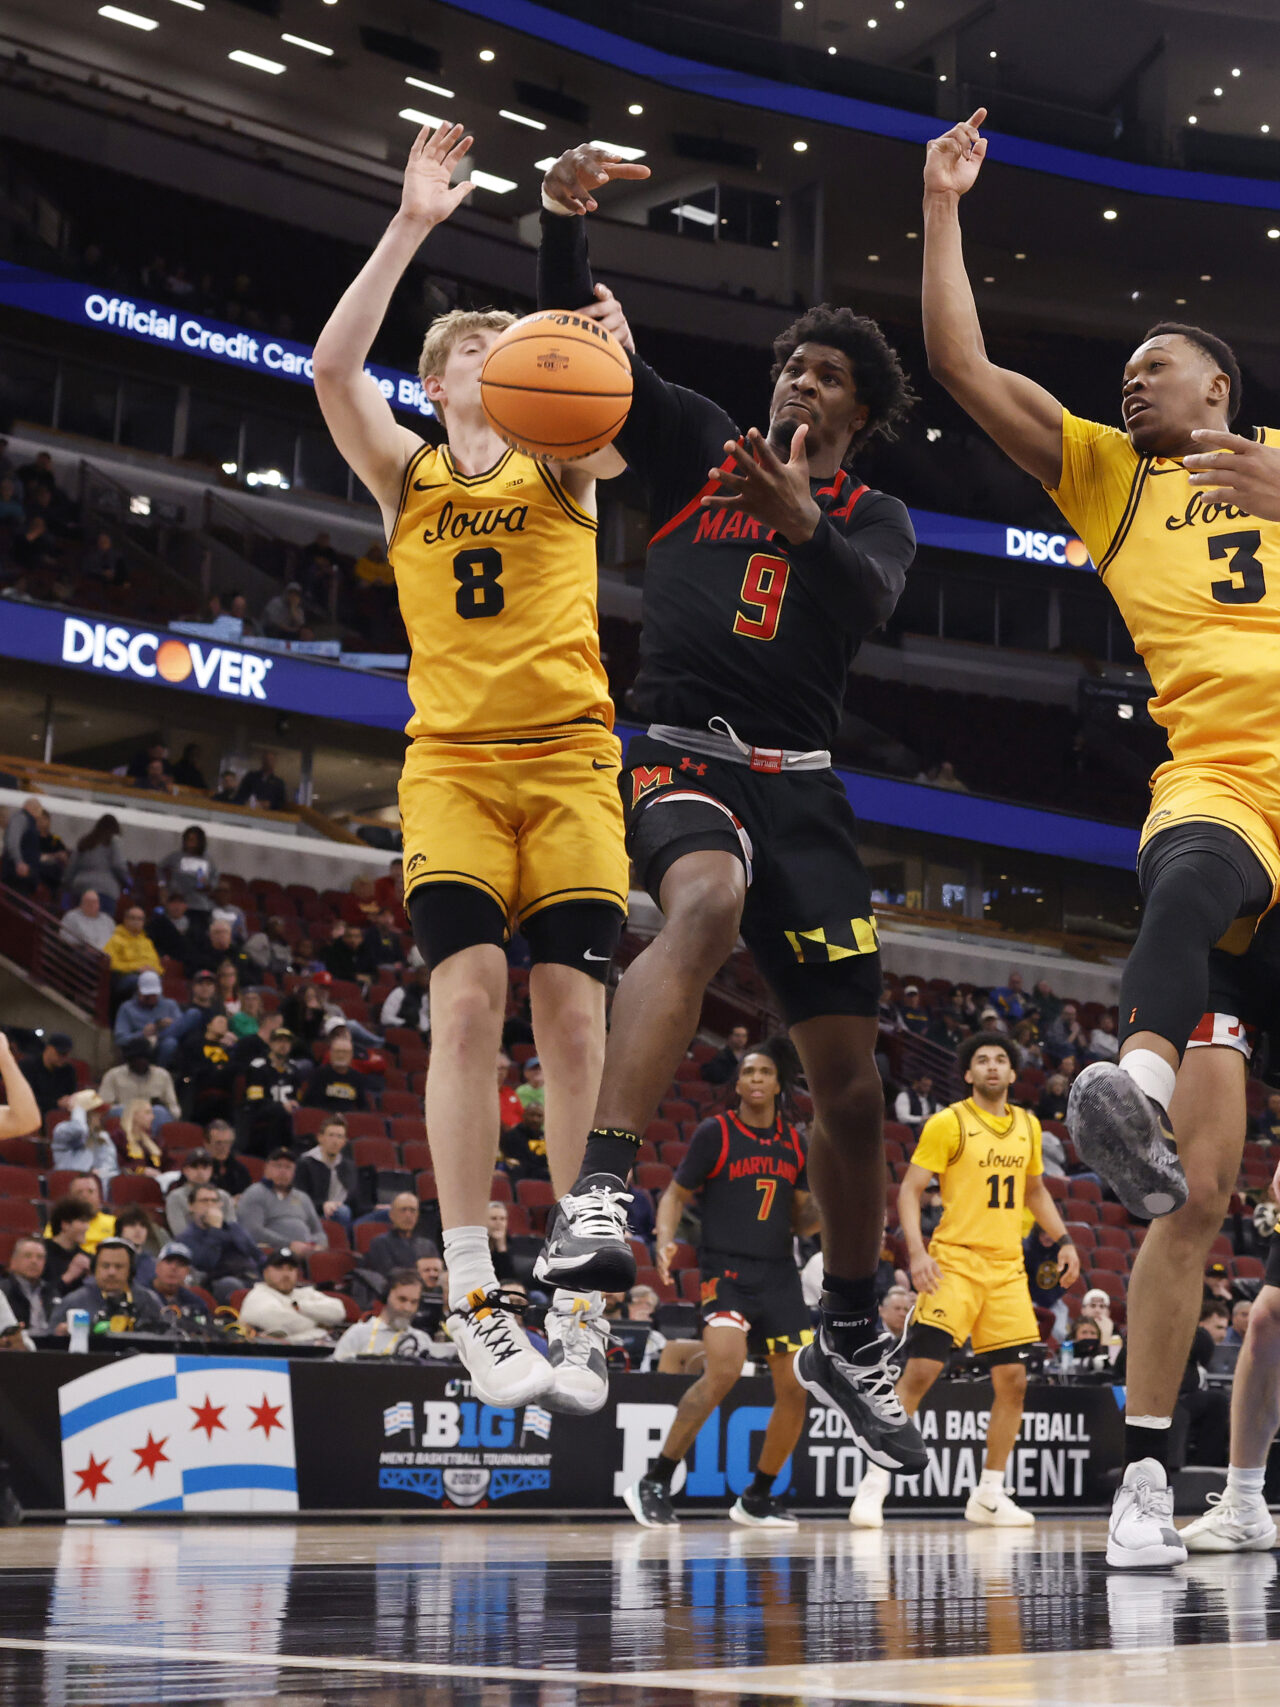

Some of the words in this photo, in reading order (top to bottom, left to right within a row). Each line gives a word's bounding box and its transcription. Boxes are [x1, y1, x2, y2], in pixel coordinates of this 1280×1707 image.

[84, 294, 178, 341] Official
[181, 320, 259, 364] Credit
[423, 501, 529, 544] Iowa
[453, 547, 504, 620] 8
[1207, 529, 1266, 605] 3
[733, 552, 790, 641] 9
[62, 617, 273, 700] DISCOVER
[729, 1156, 798, 1185] MARYLAND
[979, 1148, 1025, 1168] Iowa
[756, 1178, 778, 1221] 7
[986, 1174, 1015, 1209] 11
[946, 1410, 1090, 1441] BASTBALL
[415, 1452, 481, 1466] BASKETBALL
[483, 1453, 552, 1466] TOURNAMENT
